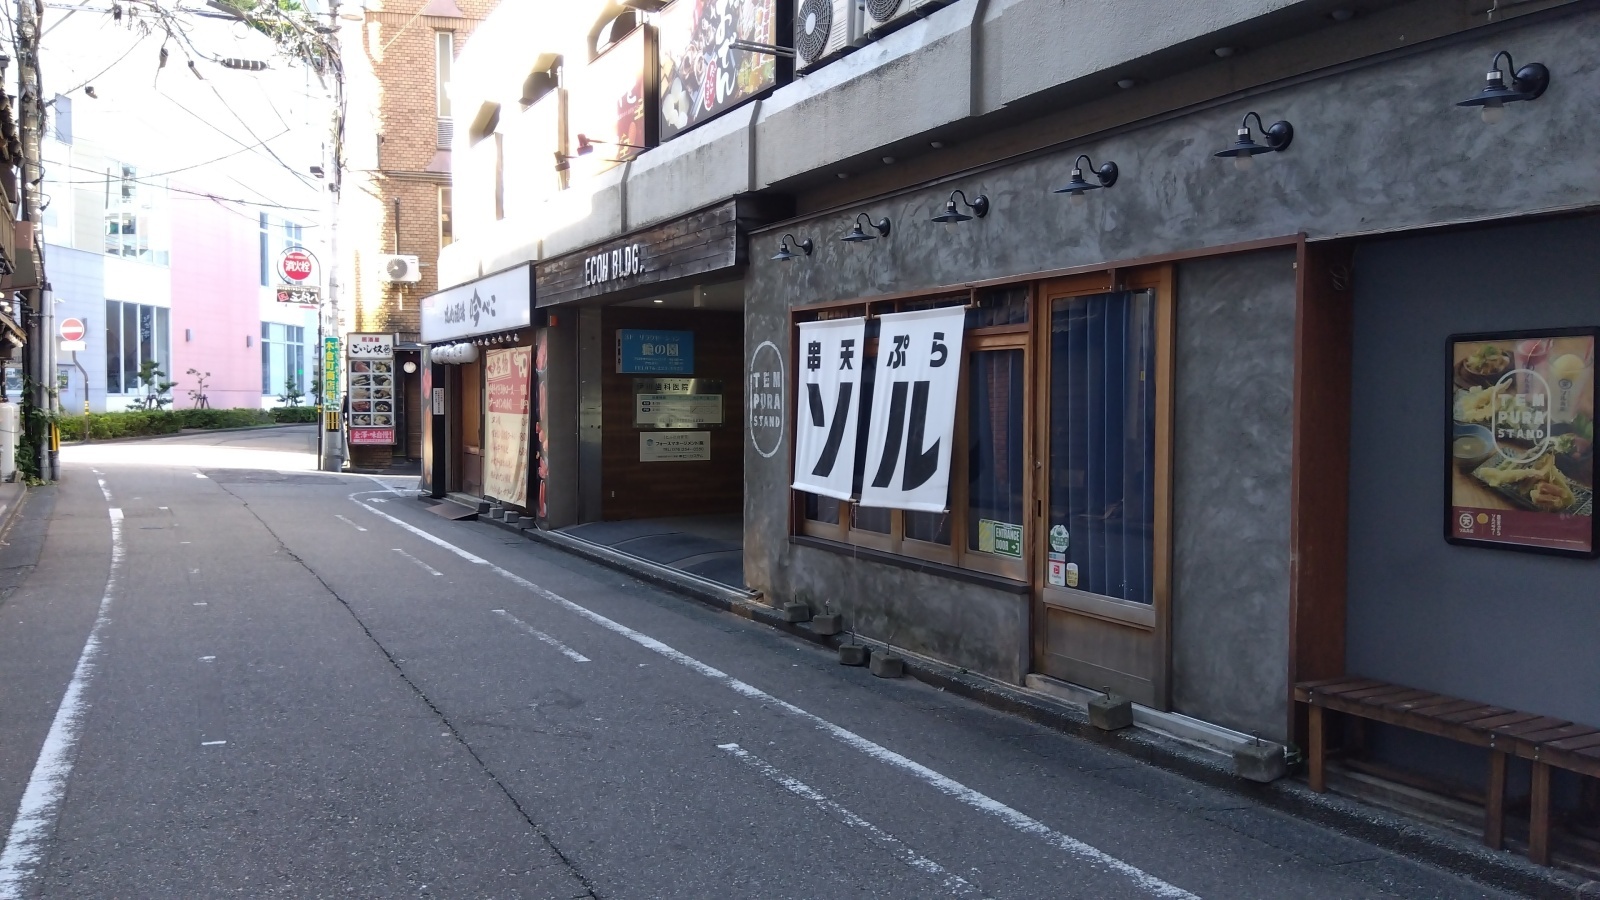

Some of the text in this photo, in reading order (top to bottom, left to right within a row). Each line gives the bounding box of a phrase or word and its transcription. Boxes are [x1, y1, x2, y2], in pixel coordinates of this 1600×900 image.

[285, 259, 311, 273] 消火栓
[585, 243, 645, 286] ECOH BLDG.
[753, 371, 780, 388] TEM
[753, 393, 780, 410] PURA
[1498, 393, 1545, 407] TEM
[753, 415, 780, 428] STAND
[1497, 410, 1545, 425] PURA
[806, 381, 941, 491] ソル
[1497, 428, 1544, 439] STAND
[995, 527, 1020, 542] ENTRANCE
[995, 539, 1009, 551] DOOR
